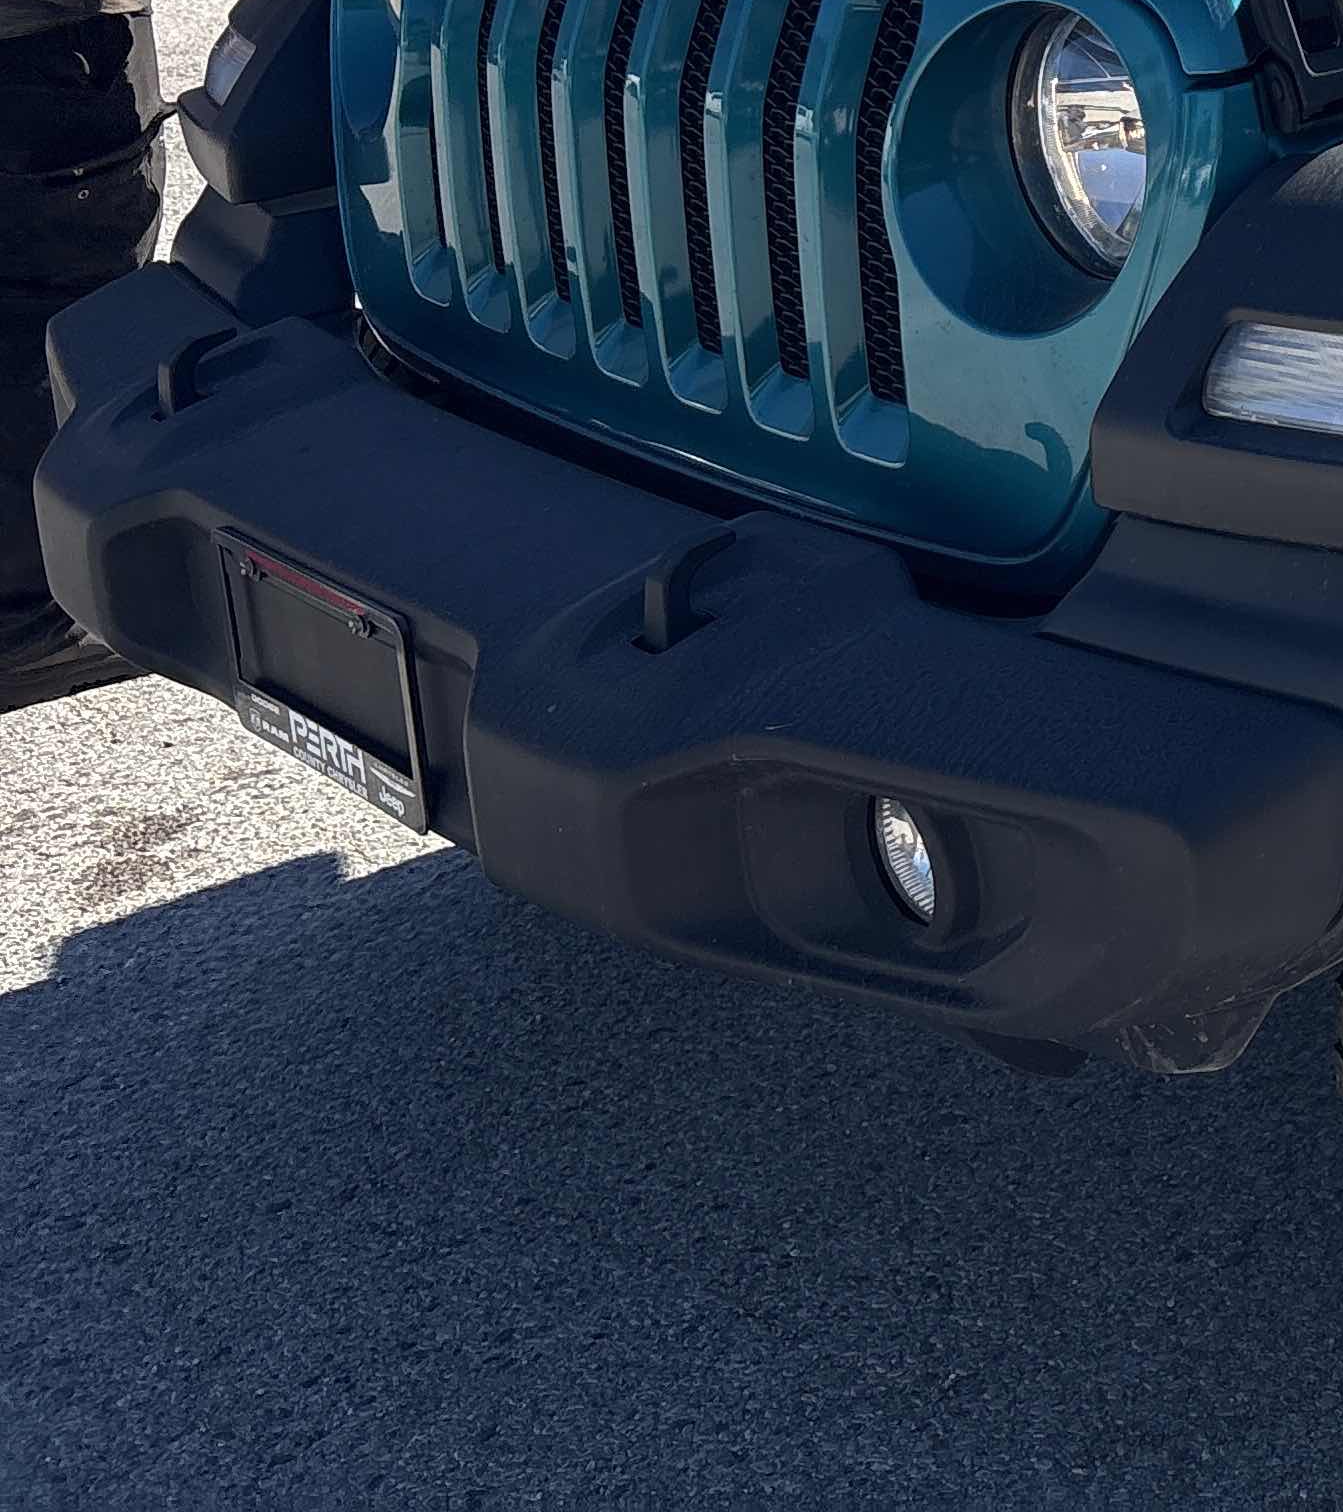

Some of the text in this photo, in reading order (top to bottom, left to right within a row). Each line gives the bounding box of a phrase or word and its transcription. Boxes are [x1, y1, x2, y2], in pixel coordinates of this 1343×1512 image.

[288, 708, 367, 785] PERTH
[293, 745, 327, 774] COUNTY
[378, 785, 405, 818] Jeep
